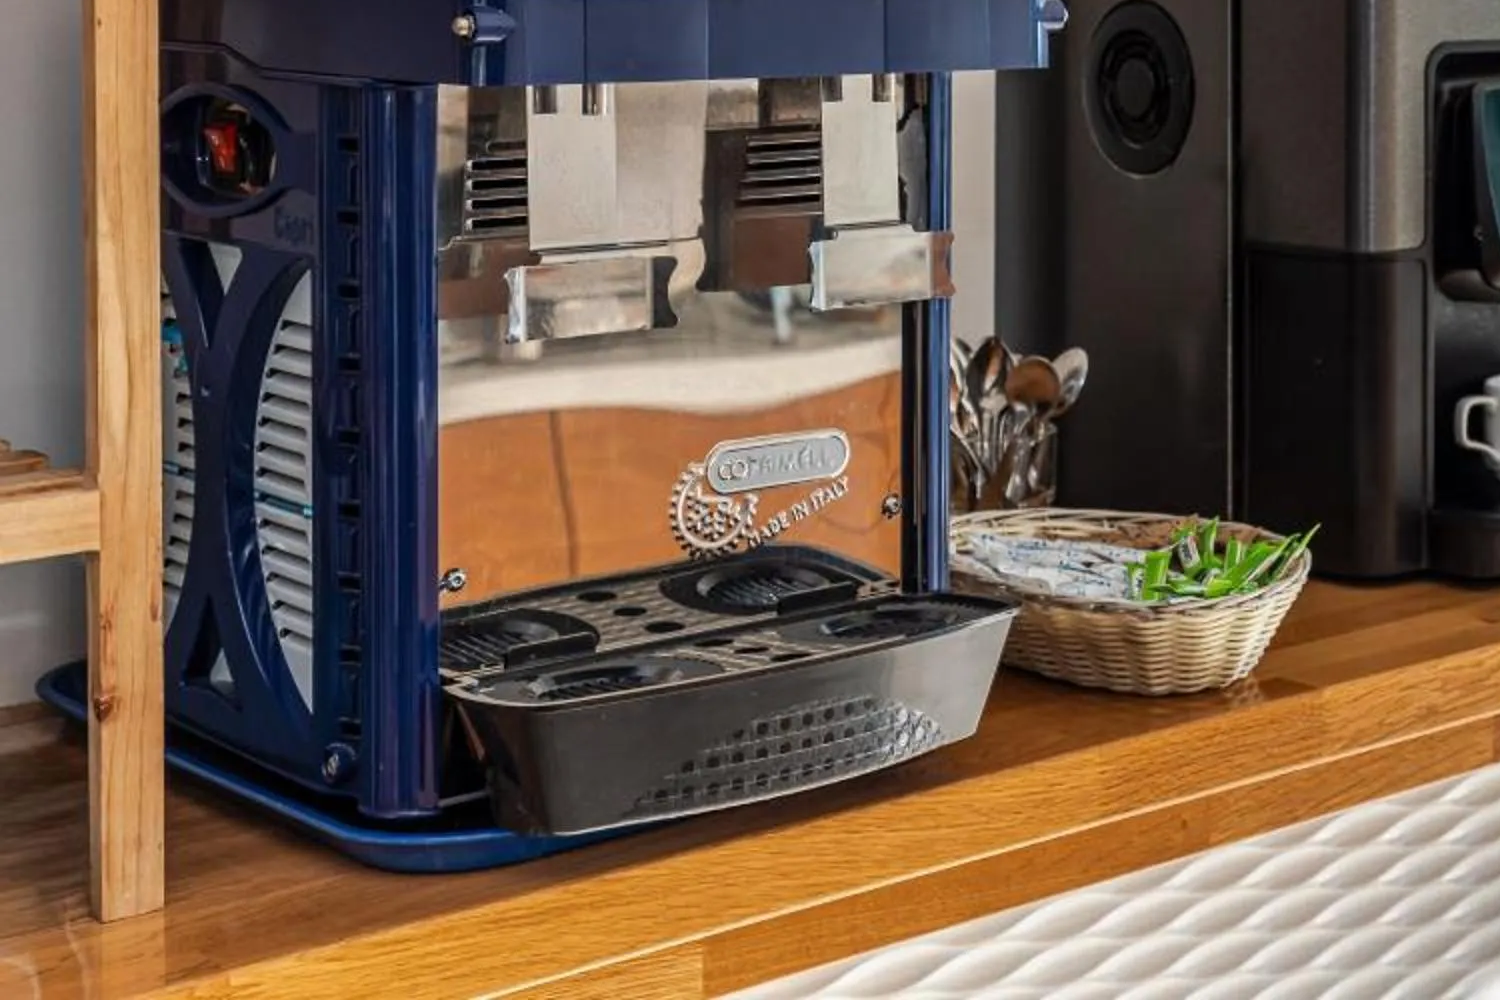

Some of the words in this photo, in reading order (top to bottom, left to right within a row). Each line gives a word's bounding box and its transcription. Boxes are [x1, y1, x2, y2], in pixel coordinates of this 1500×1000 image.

[748, 510, 790, 548] MADE
[792, 500, 809, 521] IN
[810, 476, 849, 510] ITALY
